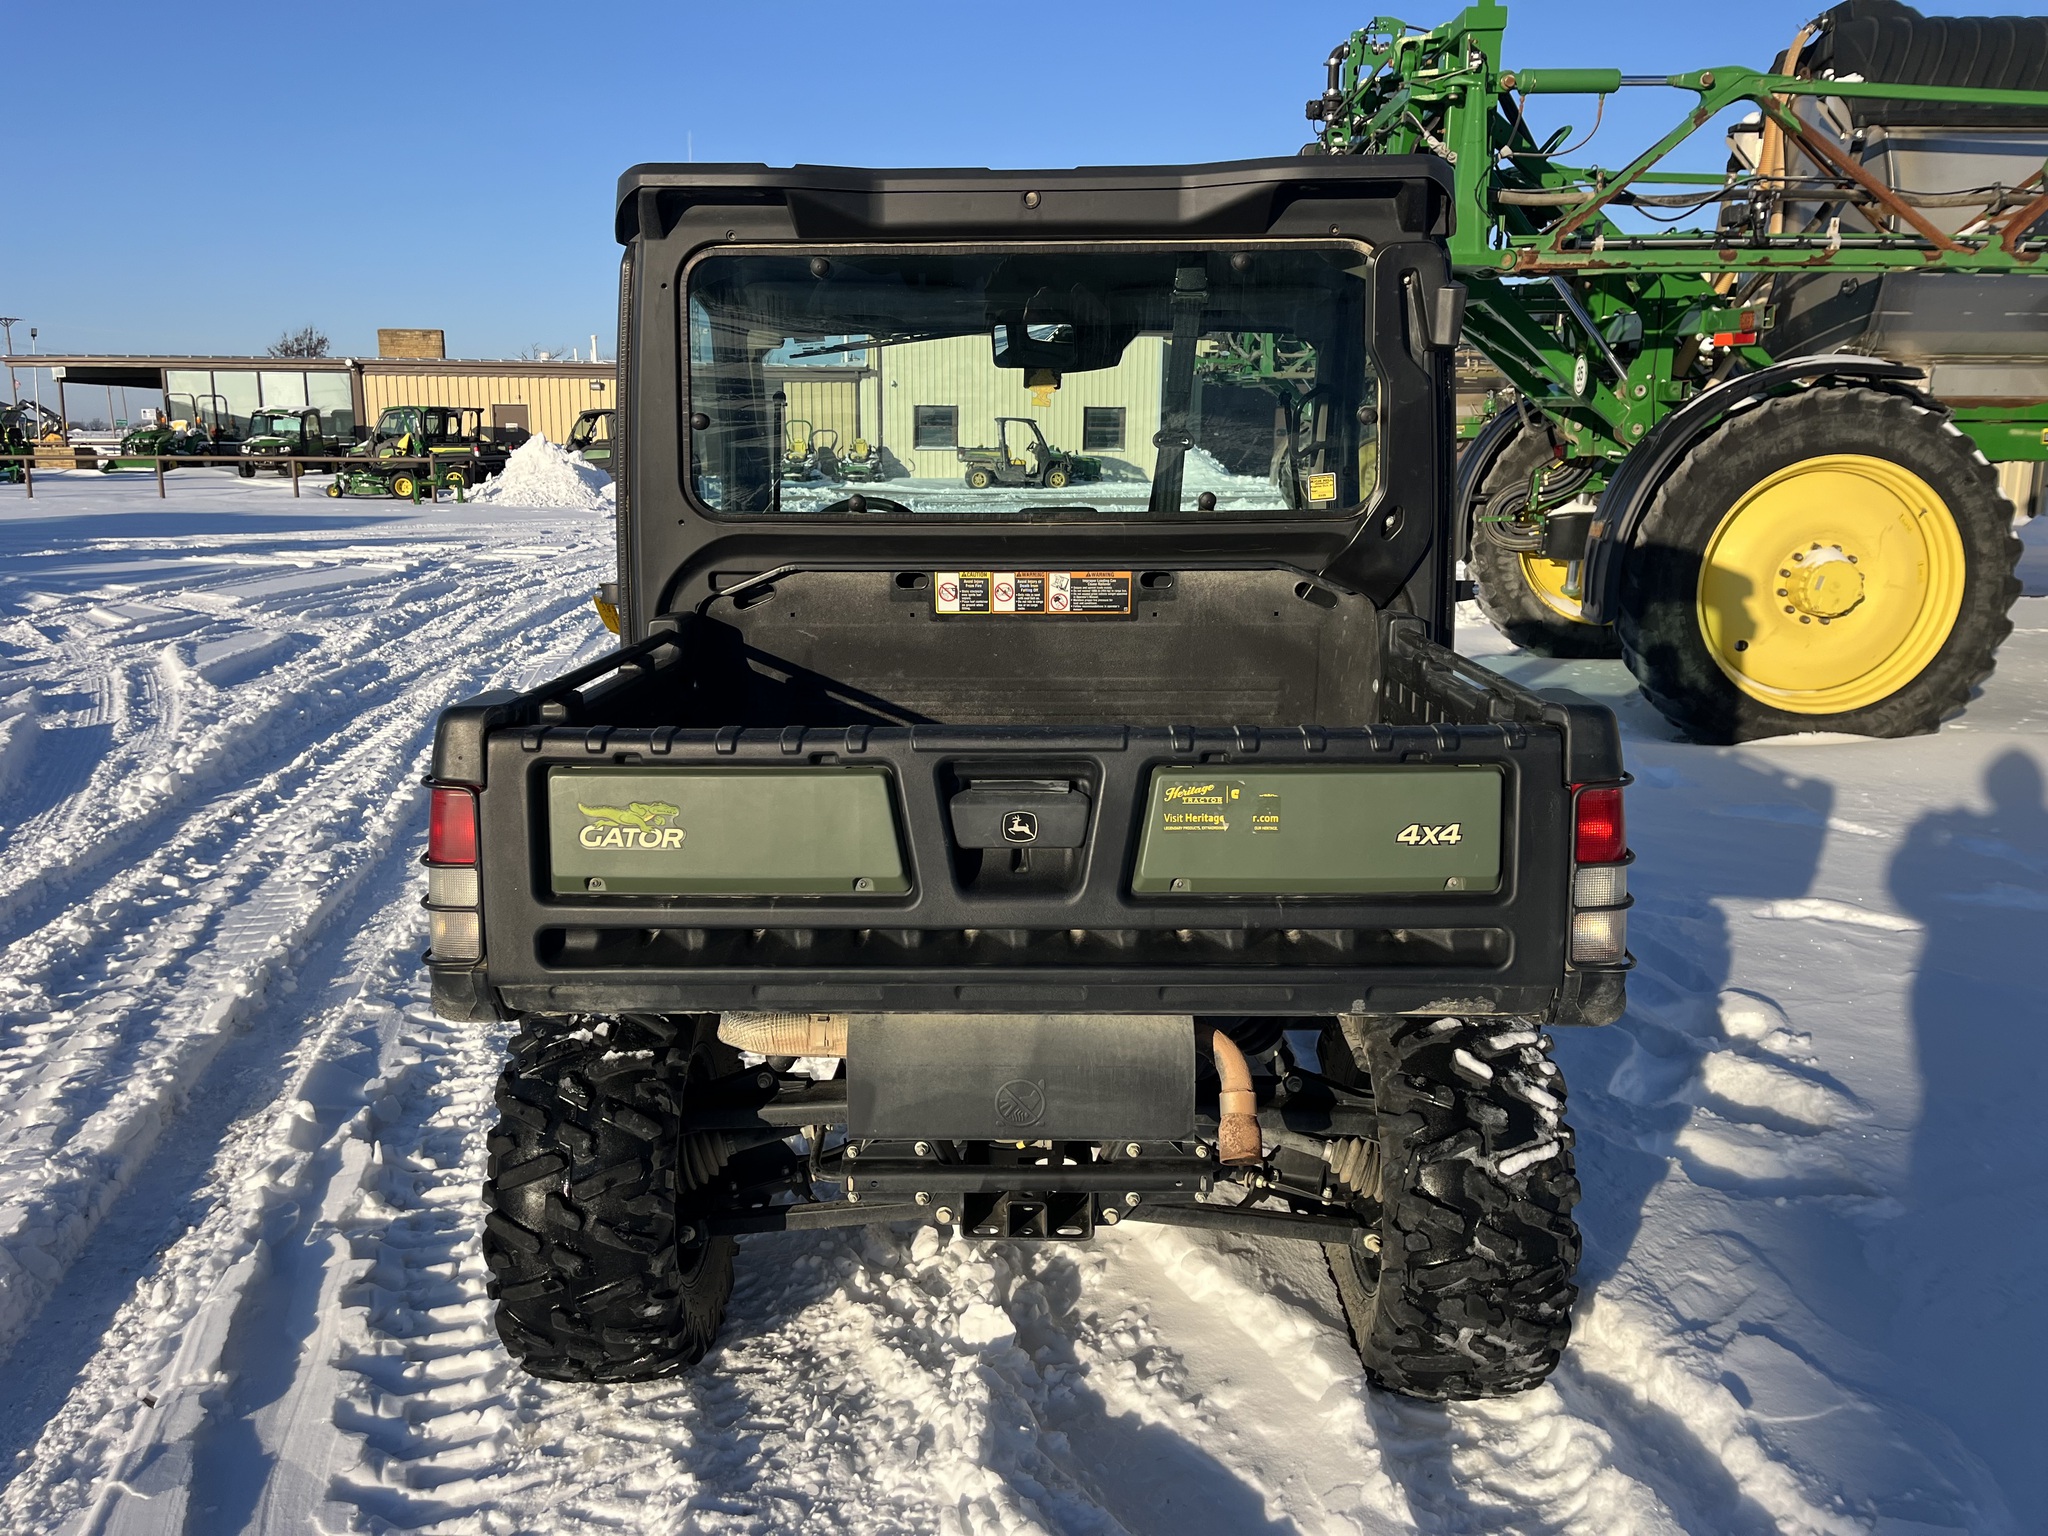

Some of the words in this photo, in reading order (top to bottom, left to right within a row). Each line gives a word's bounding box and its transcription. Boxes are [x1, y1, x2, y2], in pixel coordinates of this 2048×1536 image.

[1164, 784, 1215, 802] Heritage
[1164, 813, 1184, 823] Visit
[579, 825, 685, 848] GATOR
